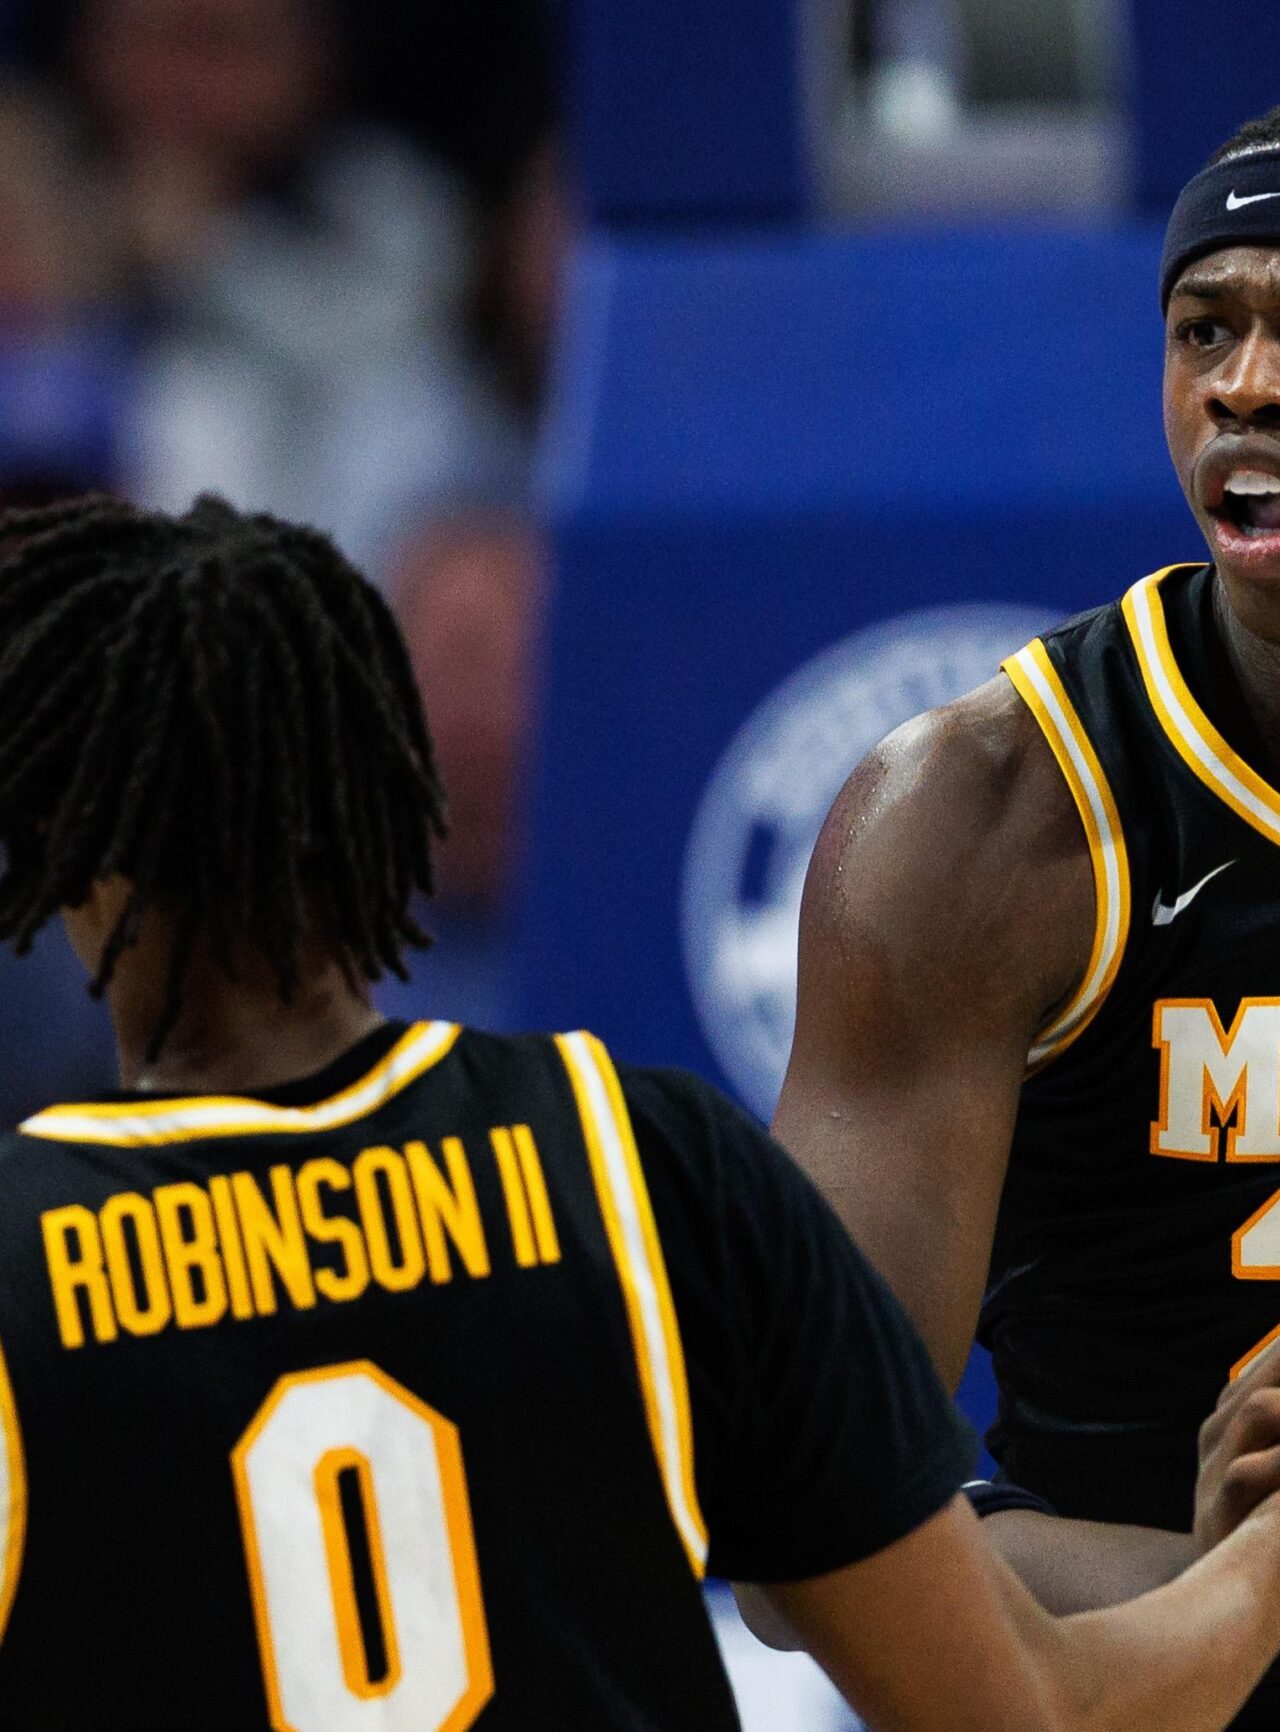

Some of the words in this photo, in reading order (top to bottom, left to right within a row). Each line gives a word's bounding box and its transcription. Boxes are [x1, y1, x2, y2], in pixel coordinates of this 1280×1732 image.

[40, 1136, 491, 1350] ROBINSON
[488, 1123, 562, 1269] II
[229, 1358, 496, 1731] 0
